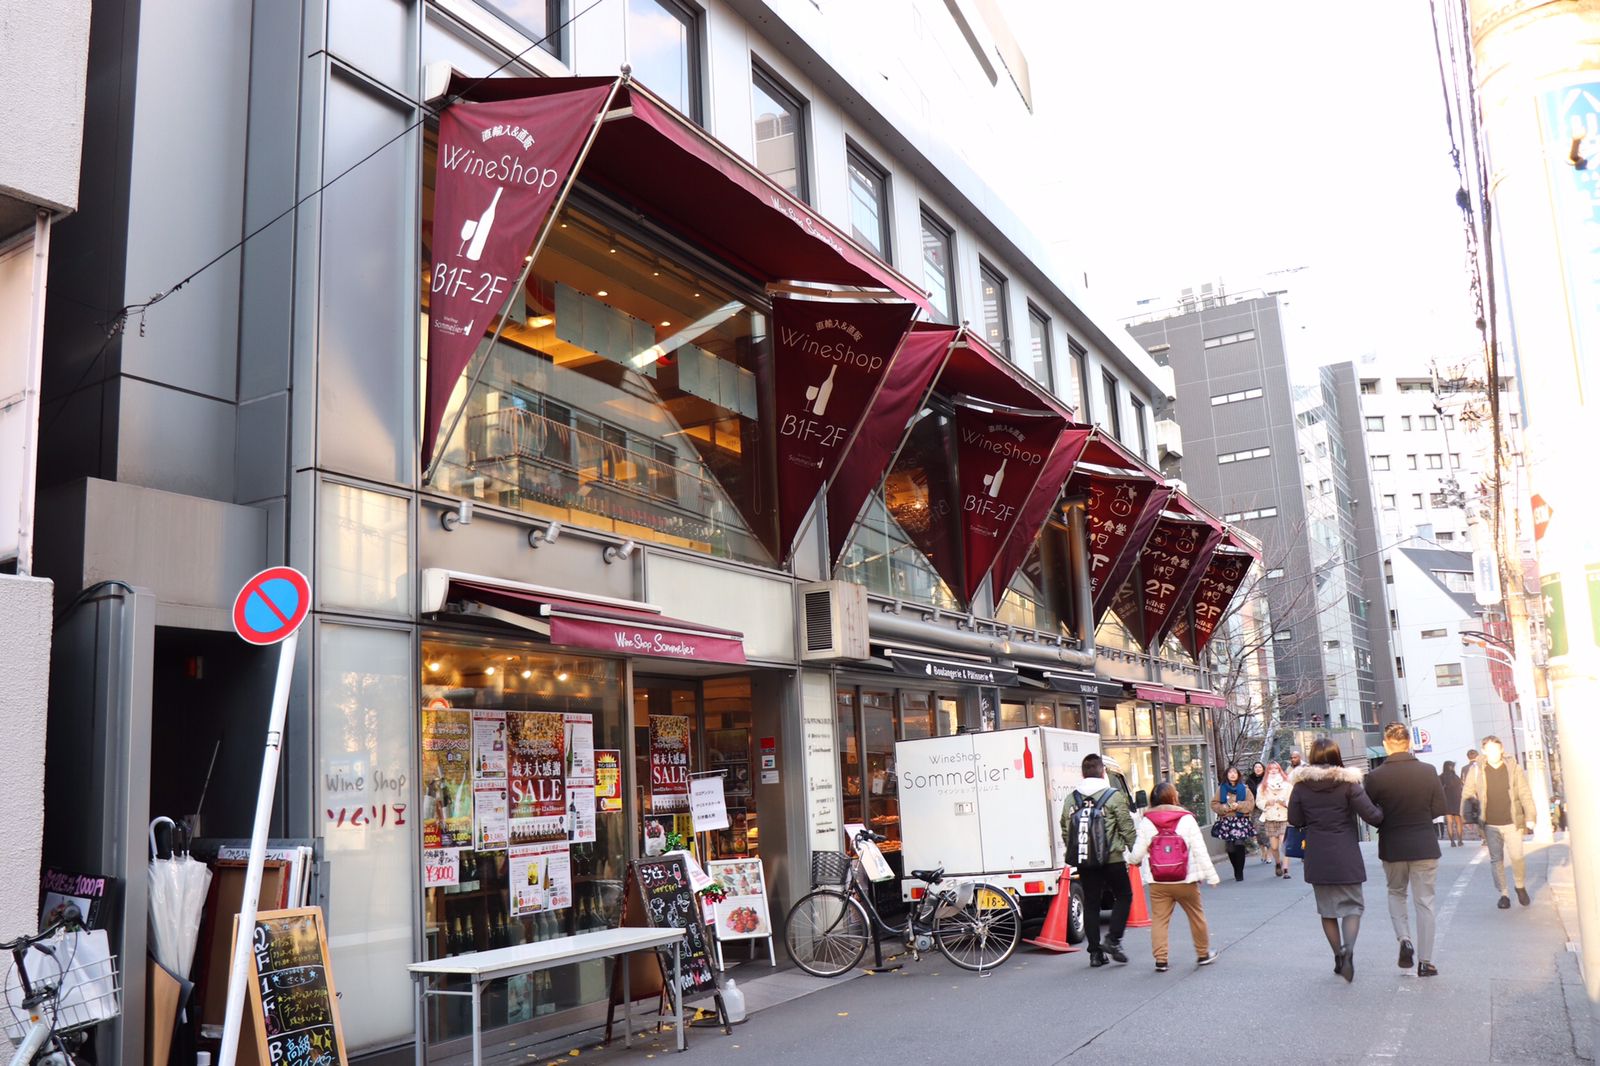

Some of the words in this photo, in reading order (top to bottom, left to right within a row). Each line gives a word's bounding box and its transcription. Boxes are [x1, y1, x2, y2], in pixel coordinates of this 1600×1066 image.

[443, 143, 558, 194] WineShop
[431, 261, 508, 305] B1F-2F
[780, 325, 883, 374] WineShop
[779, 413, 848, 448] B1F-2F
[961, 426, 1042, 466] WineShop
[963, 494, 1016, 523] B1F-2F
[1144, 578, 1176, 599] 2F
[1200, 577, 1234, 595] イン食堂
[1195, 601, 1221, 619] 2F
[614, 631, 634, 648] Wine
[633, 633, 652, 652] Shop
[653, 633, 696, 656] Sommelier
[928, 752, 982, 765] WineShop
[325, 768, 365, 793] Wine
[373, 769, 407, 797] Shop
[653, 766, 688, 784] SALE
[903, 764, 1009, 790] Sommelier
[511, 779, 562, 803] SALE
[1078, 808, 1091, 864] DIESEL
[286, 1034, 313, 1062] 高級
